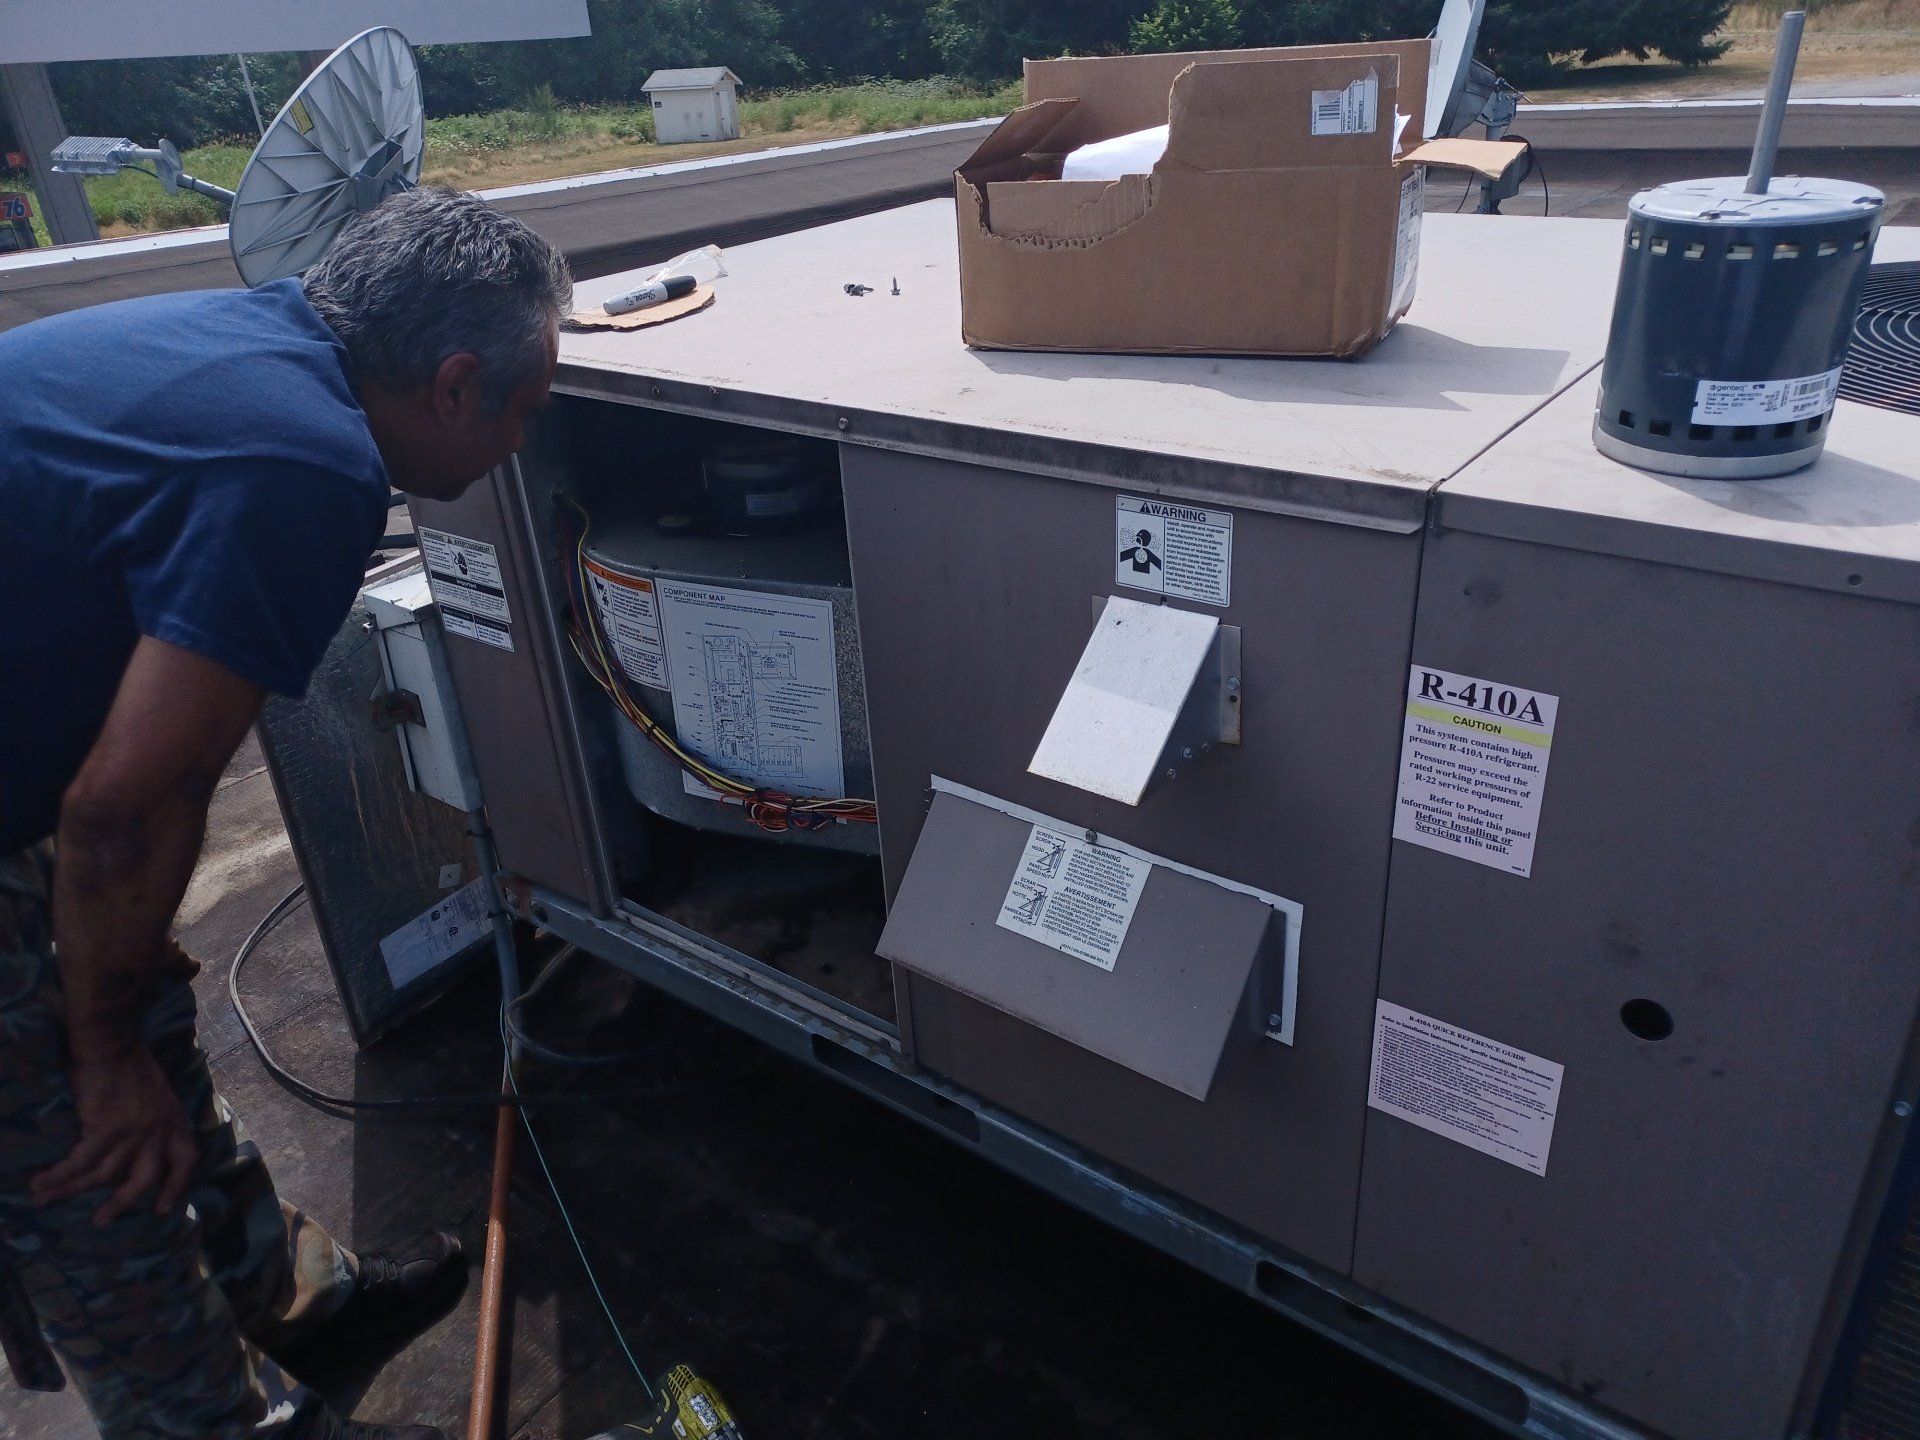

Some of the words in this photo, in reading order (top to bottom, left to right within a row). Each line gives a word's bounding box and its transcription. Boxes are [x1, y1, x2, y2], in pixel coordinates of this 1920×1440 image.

[2, 197, 26, 218] 76
[1716, 384, 1745, 392] genteq
[1151, 504, 1206, 522] WARNING
[663, 587, 707, 599] COMPONENT
[1420, 672, 1541, 723] R-410A
[1415, 723, 1435, 735] This
[1437, 731, 1468, 743] system
[1470, 739, 1509, 753] contains
[1511, 747, 1532, 759] high
[1452, 715, 1501, 734] CAUTION
[1408, 735, 1446, 749] pressure
[1449, 743, 1483, 758] R-410A
[1485, 754, 1539, 772] refrigerant.
[1413, 750, 1455, 768] Pressures
[1457, 763, 1477, 774] may
[1479, 769, 1510, 782] exceed
[1513, 776, 1528, 786] the
[1409, 762, 1432, 773] rated
[1435, 768, 1472, 784] working
[1474, 779, 1517, 795] pressures
[1519, 790, 1531, 798] of
[1415, 772, 1436, 784] R-22
[1438, 780, 1469, 793] service
[1471, 789, 1522, 808] equipment.
[1401, 796, 1452, 817] information
[1457, 812, 1483, 826] inside
[1485, 821, 1503, 831] this
[1504, 827, 1530, 839] panel
[1429, 793, 1454, 806] Refer
[1455, 801, 1464, 810] to
[1466, 804, 1503, 820] Product
[1036, 830, 1054, 839] SCREEN
[1415, 810, 1447, 826] Before
[1450, 820, 1498, 841] Installing
[1500, 836, 1513, 844] or
[1415, 820, 1461, 841] Servicing
[1464, 835, 1483, 847] this
[1485, 843, 1509, 855] unit.
[1091, 847, 1121, 862] WARNING
[1063, 886, 1116, 909] AVERTISSEMENT
[1381, 1015, 1395, 1023] Refer
[1401, 1022, 1429, 1036] Installation
[1430, 1032, 1460, 1047] Instructions
[1469, 1048, 1488, 1058] specific
[1488, 1054, 1518, 1068] installation
[1518, 1066, 1553, 1081] requirements
[1409, 1015, 1431, 1027] R-410A
[1432, 1024, 1455, 1036] QUICK
[1457, 1032, 1500, 1053] REFERENCE
[1501, 1049, 1526, 1062] GUIDE
